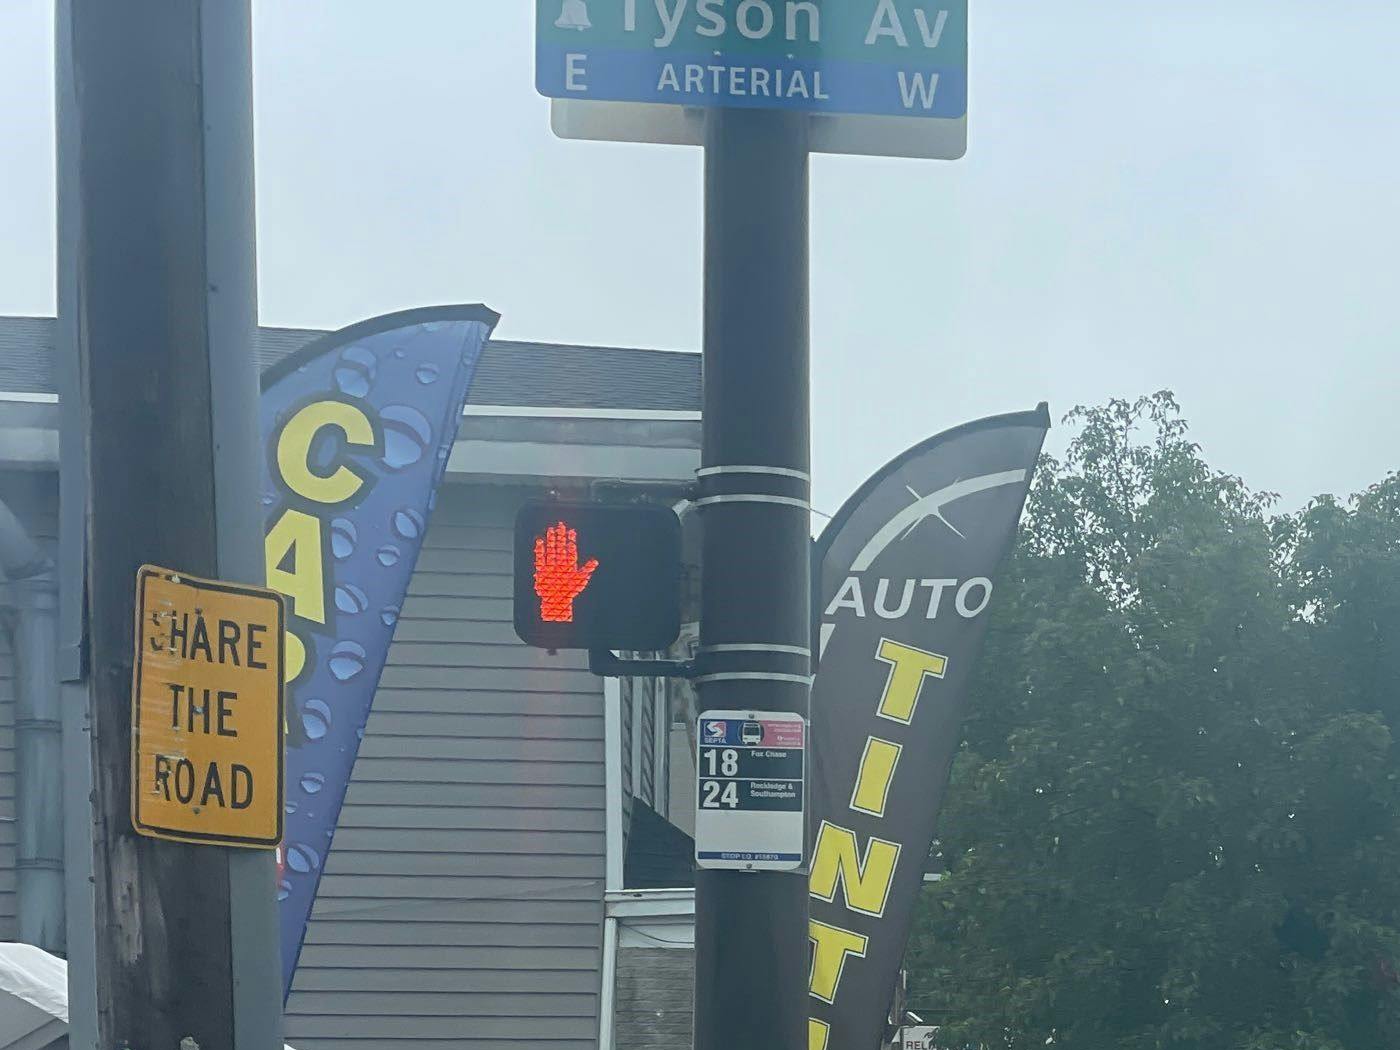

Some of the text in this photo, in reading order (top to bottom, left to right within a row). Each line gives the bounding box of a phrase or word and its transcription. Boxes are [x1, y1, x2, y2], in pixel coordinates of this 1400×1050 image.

[864, 0, 948, 48] Av
[565, 54, 940, 109] E ARTERIAL W
[824, 576, 994, 620] AUTO
[150, 610, 268, 670] SHARE
[163, 682, 238, 738] THE
[704, 749, 738, 776] 18
[751, 750, 764, 758] Fox
[154, 753, 254, 810] ROAD
[703, 781, 739, 809] 24
